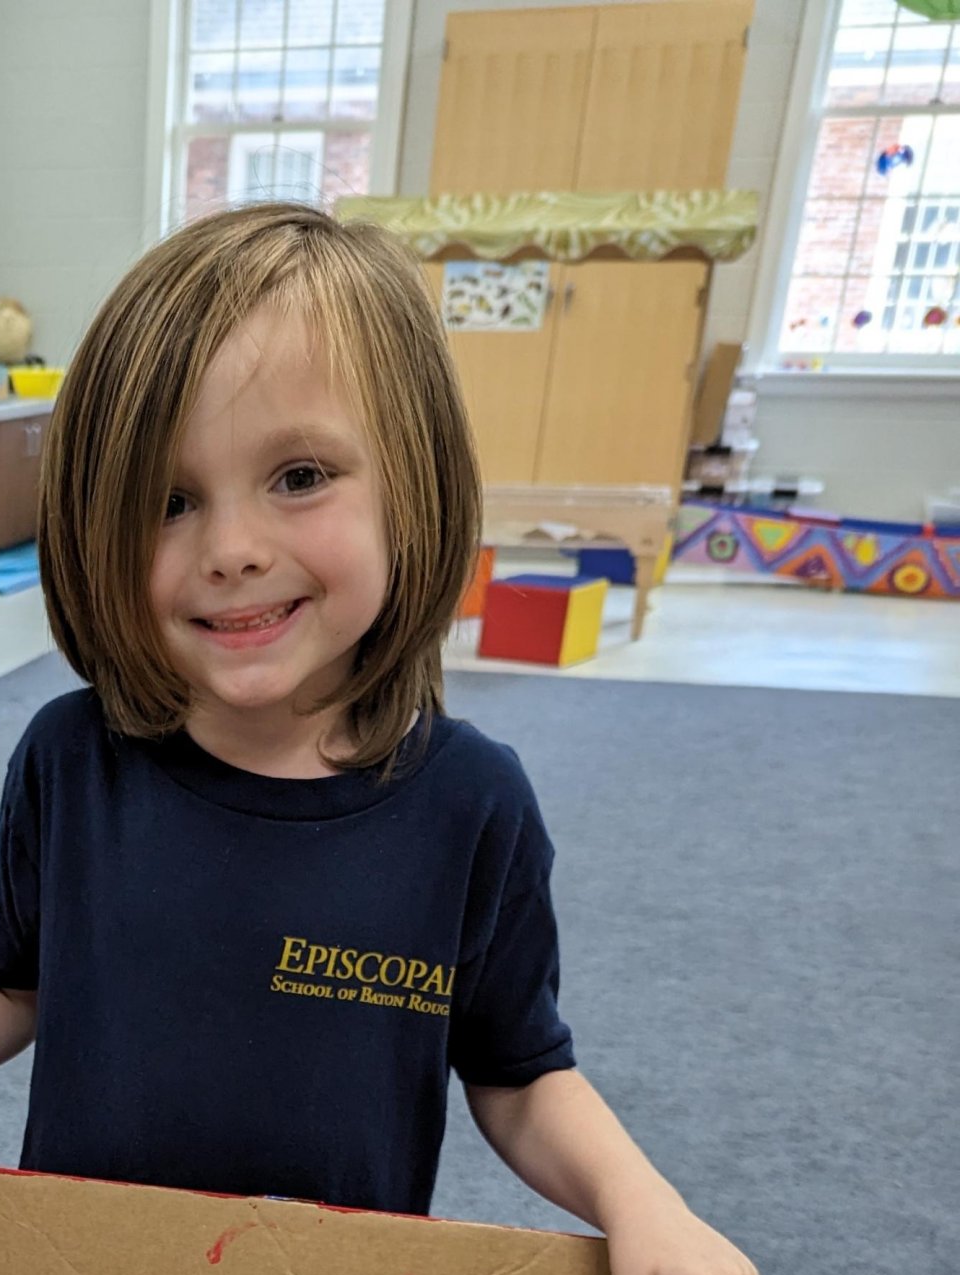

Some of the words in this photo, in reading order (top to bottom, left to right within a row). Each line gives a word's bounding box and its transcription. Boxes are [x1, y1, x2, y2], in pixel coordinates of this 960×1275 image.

[270, 975, 334, 999] SCHOOL
[337, 987, 357, 1001] OF
[360, 986, 405, 1008] BATON
[407, 993, 450, 1016] ROUG
